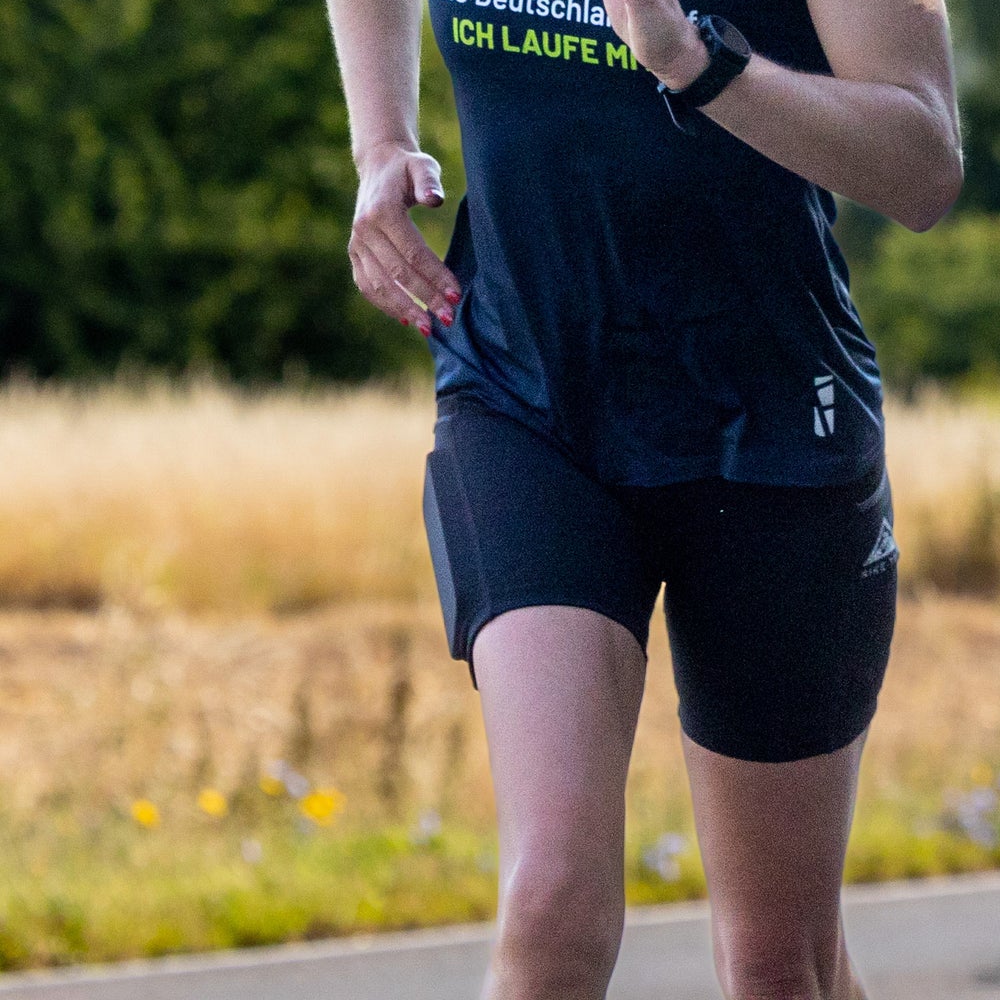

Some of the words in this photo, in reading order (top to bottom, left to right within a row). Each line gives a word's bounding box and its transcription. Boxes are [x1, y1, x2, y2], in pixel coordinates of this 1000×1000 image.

[452, 16, 494, 50] ICH
[501, 25, 599, 65] LAUFE
[605, 41, 648, 71] MI
